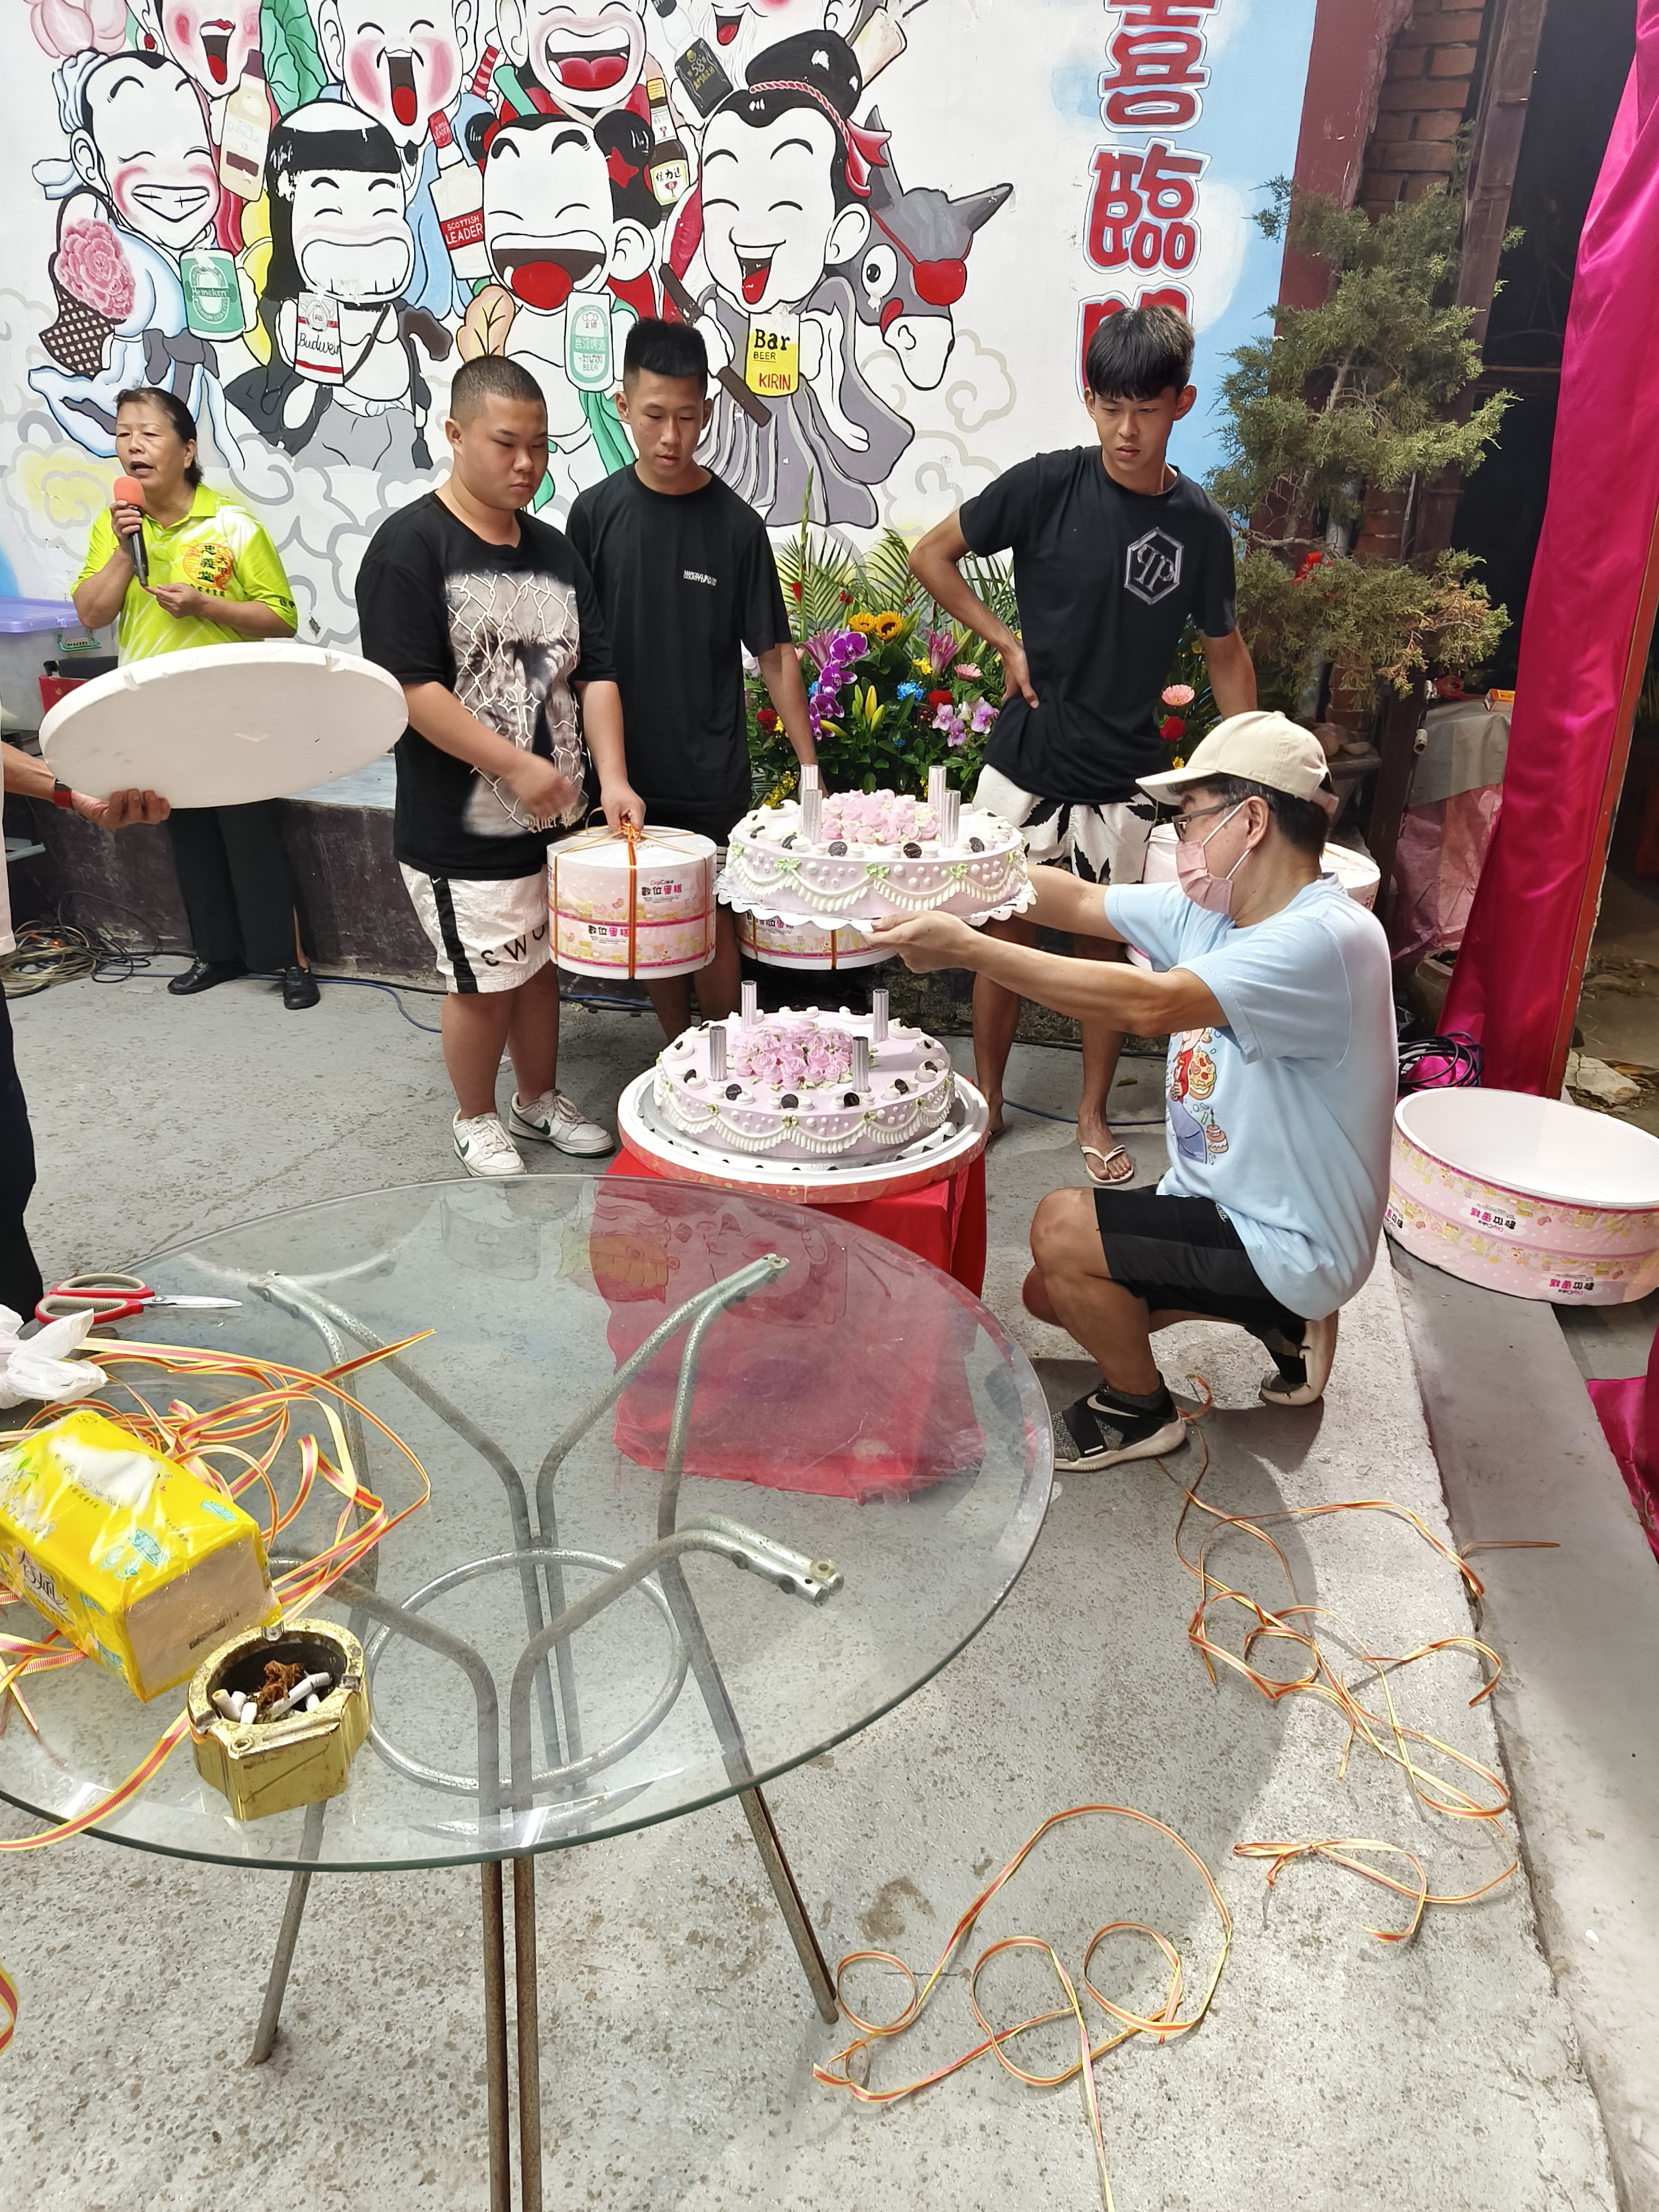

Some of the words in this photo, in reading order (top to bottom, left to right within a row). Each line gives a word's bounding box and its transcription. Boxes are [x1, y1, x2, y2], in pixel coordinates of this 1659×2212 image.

[447, 214, 480, 231] SCOTTISH
[445, 223, 483, 245] LEADER
[192, 287, 227, 297] Heineken
[754, 328, 791, 351] Bar
[753, 352, 776, 360] BEER
[759, 373, 791, 390] KIRIN
[642, 884, 682, 896] 數位蛋糕
